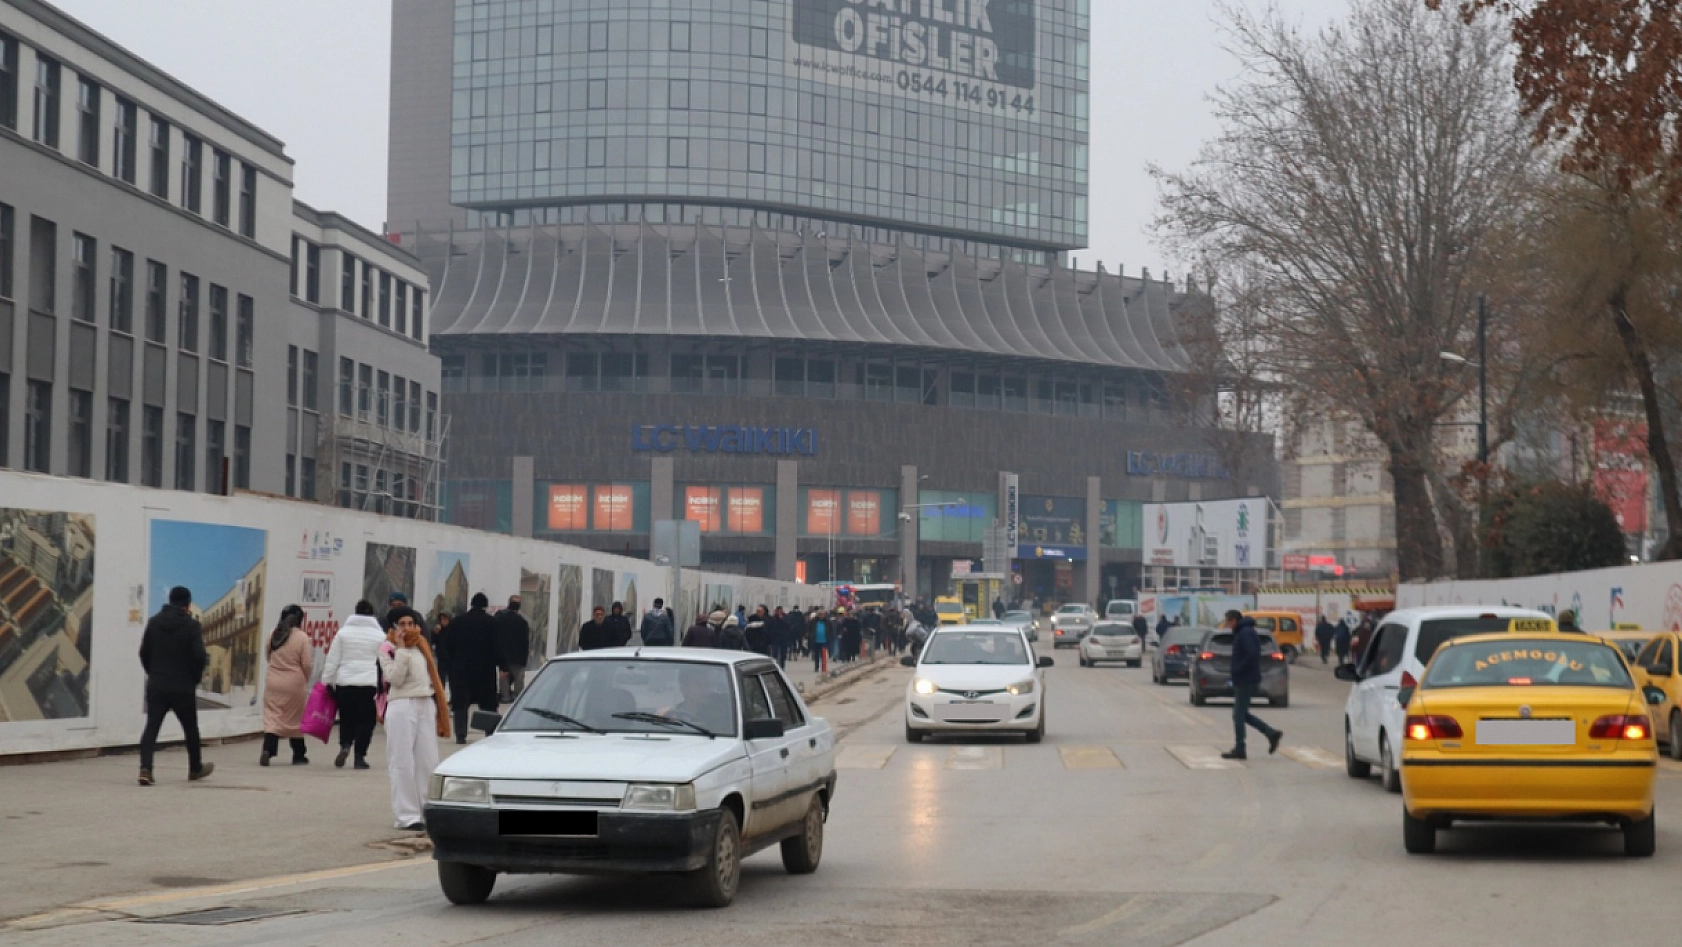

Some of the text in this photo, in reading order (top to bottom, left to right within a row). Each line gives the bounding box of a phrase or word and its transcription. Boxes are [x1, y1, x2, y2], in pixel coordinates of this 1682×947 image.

[897, 70, 948, 98] 0544
[953, 80, 982, 105] 114
[987, 87, 1007, 110] 91
[1011, 94, 1034, 115] 44
[631, 423, 678, 452] LC
